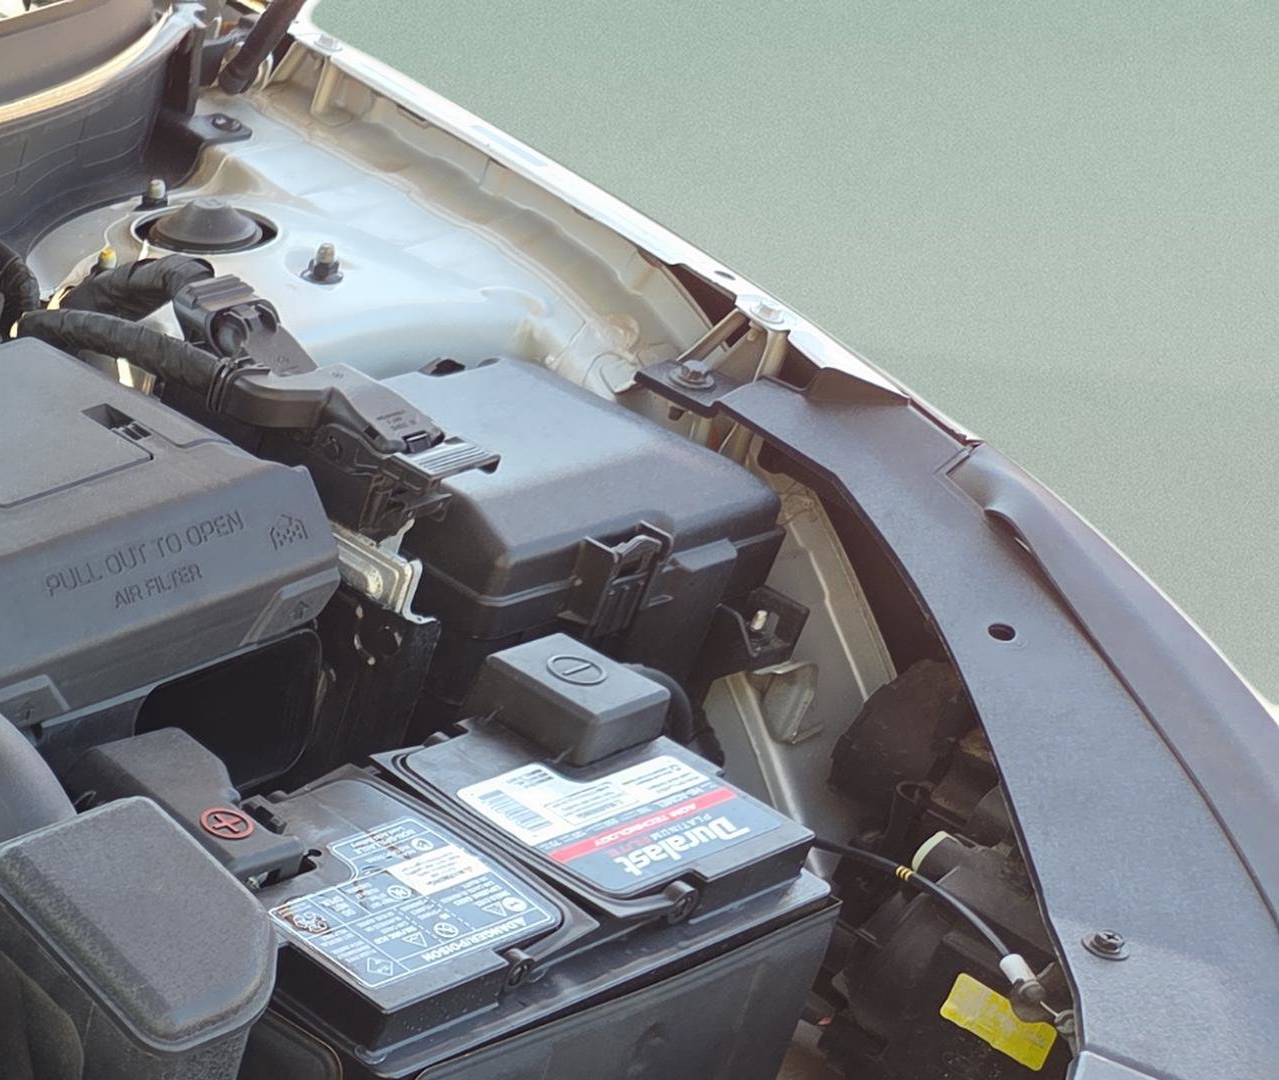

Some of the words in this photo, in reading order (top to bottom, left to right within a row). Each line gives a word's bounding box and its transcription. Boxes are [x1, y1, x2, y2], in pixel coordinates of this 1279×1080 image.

[45, 565, 103, 597] PULL
[105, 543, 147, 576] OUT
[153, 532, 183, 559] TO
[186, 510, 245, 547] OPEN
[114, 582, 142, 608] AIR
[145, 563, 203, 597] FILTER
[613, 816, 751, 877] Duralast
[649, 813, 713, 841] PLATINUM
[418, 918, 521, 963] DANGER/POISON
